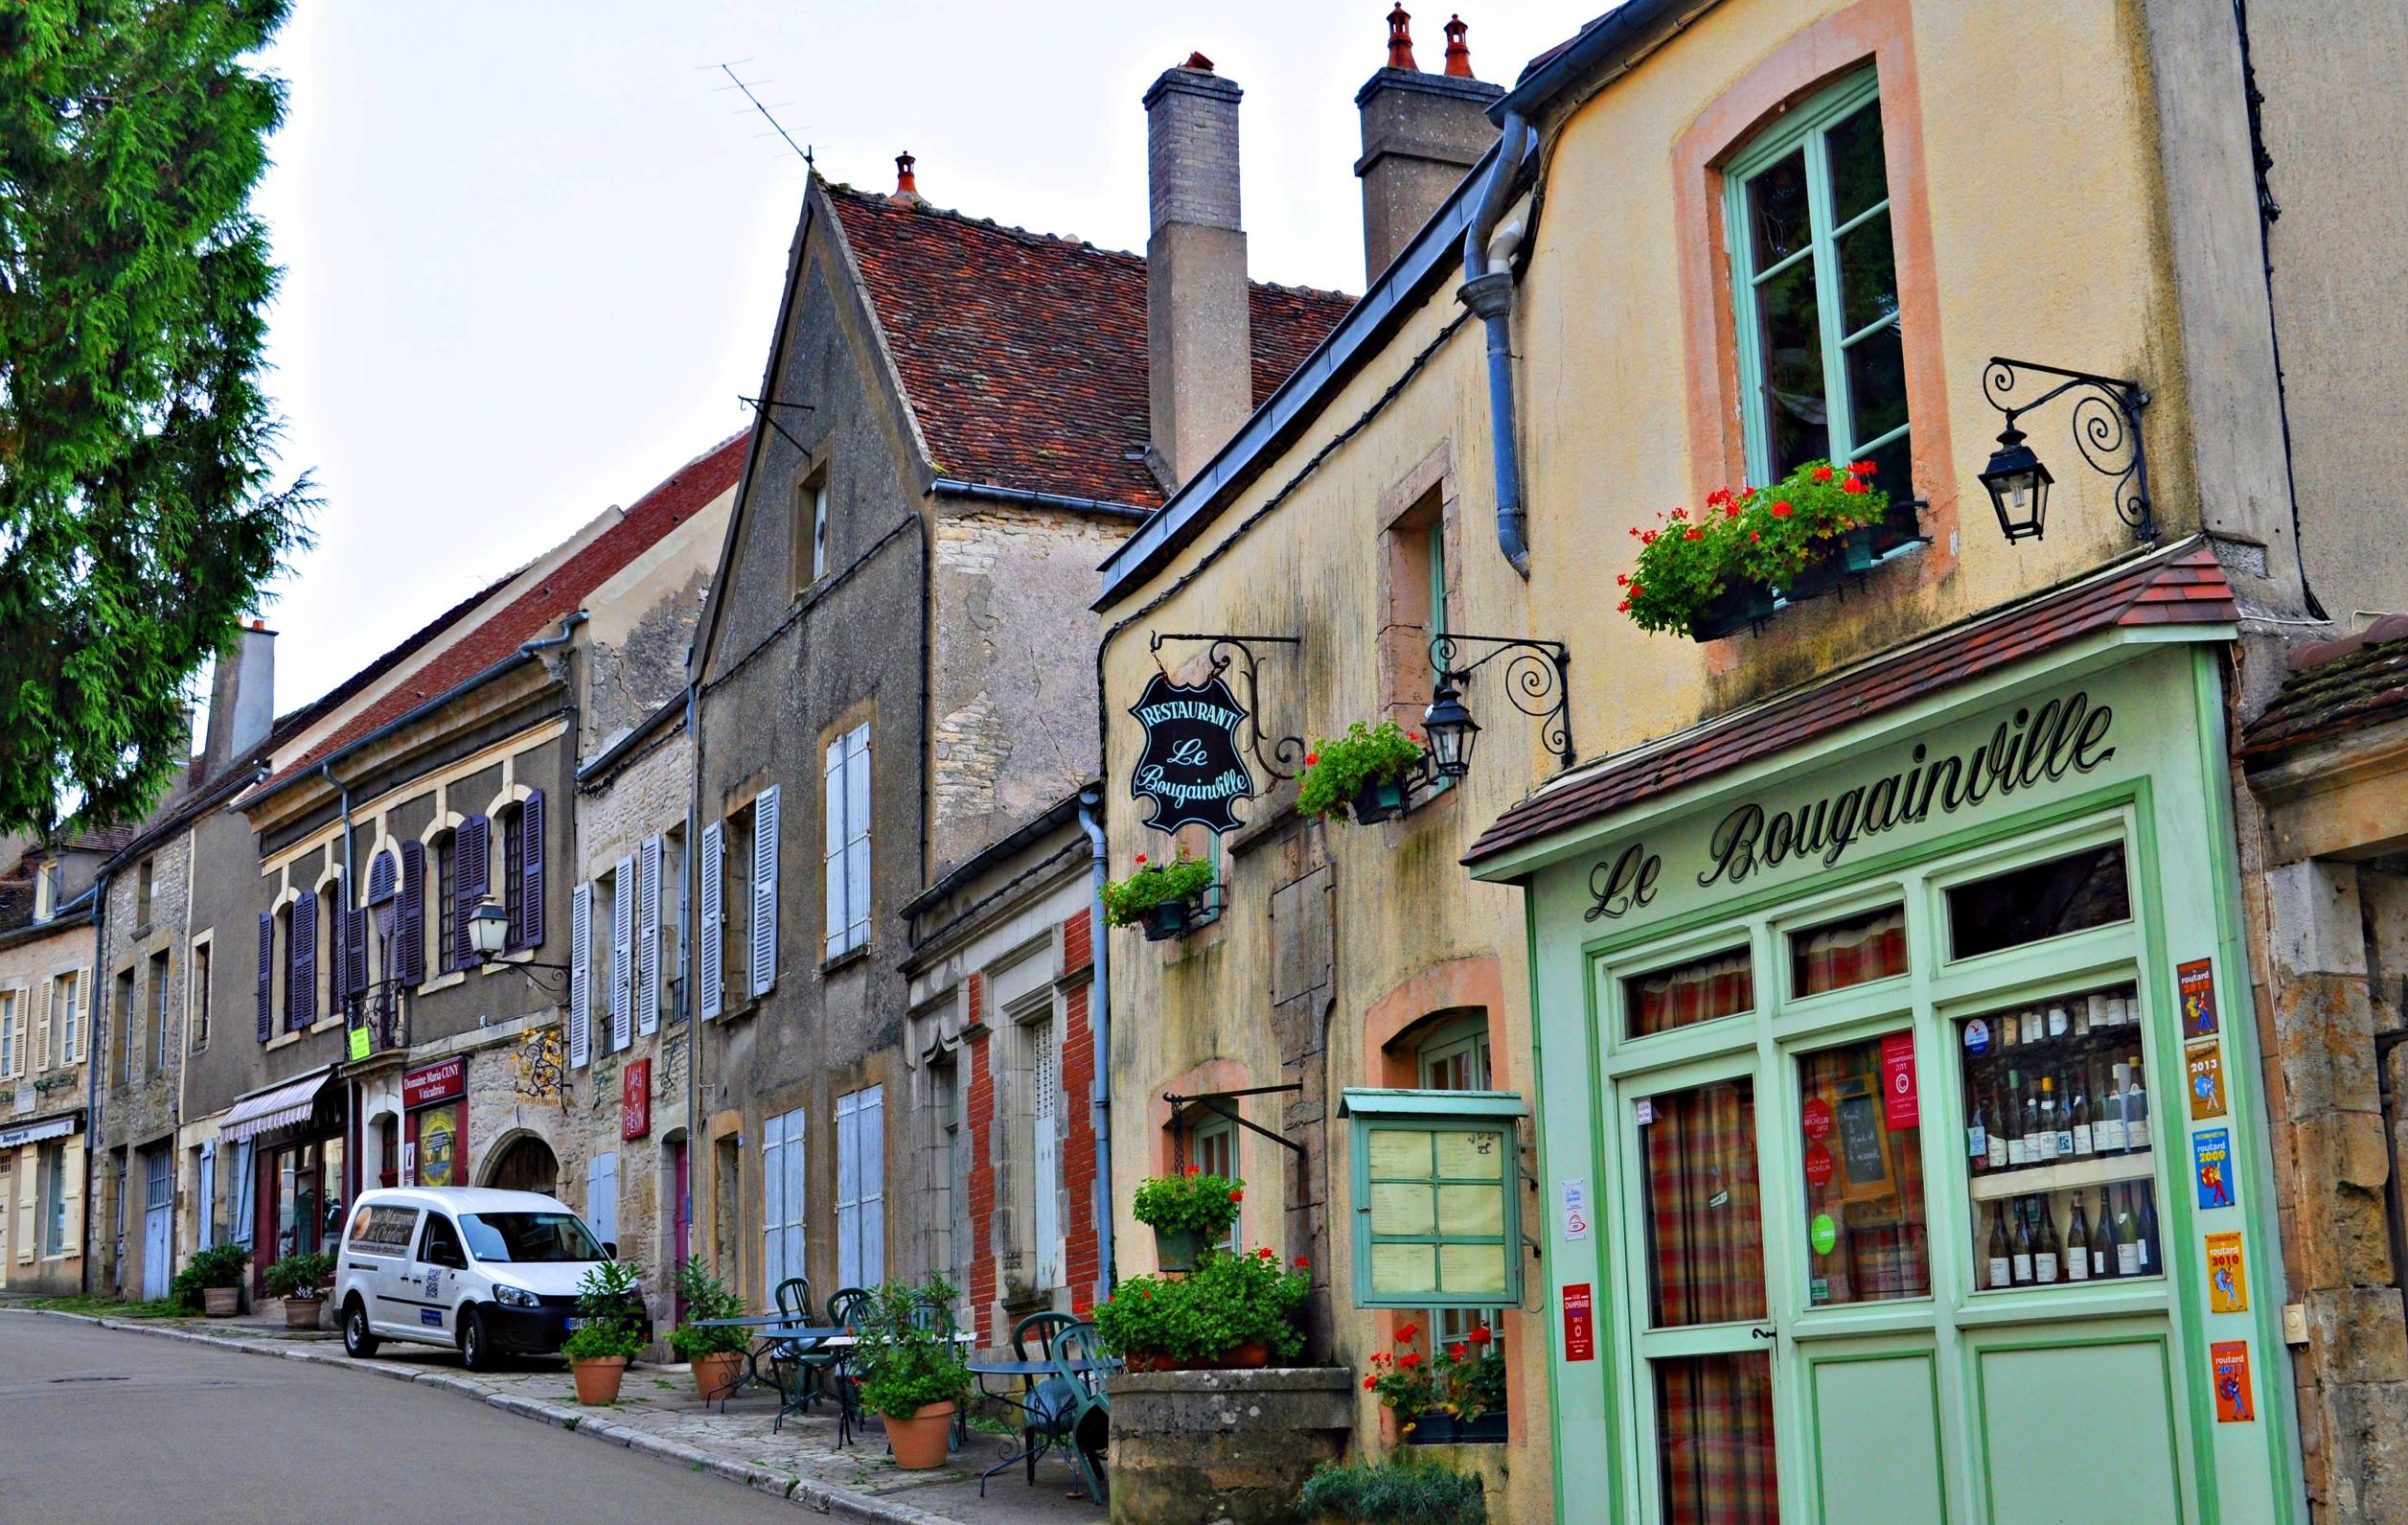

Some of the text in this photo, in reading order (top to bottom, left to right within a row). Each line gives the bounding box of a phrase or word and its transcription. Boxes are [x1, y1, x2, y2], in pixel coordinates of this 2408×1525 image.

[1140, 702, 1237, 730] RESTAURANT
[1167, 739, 1207, 765] Le
[1137, 765, 1247, 808] Bougainville
[1584, 691, 2116, 923] Le Bougainville
[2182, 971, 2209, 984] routard
[1895, 1063, 1907, 1072] 2011
[2191, 1059, 2217, 1073] 2013
[404, 1064, 459, 1090] Domaine Maria CUNY
[1804, 1117, 1829, 1126] MICHELIN
[2198, 1142, 2225, 1153] routard
[1807, 1165, 1831, 1173] MICHELIN
[2210, 1245, 2238, 1256] routard
[2213, 1256, 2238, 1266] 2010
[2215, 1354, 2244, 1364] routard
[2218, 1365, 2244, 1375] 2011
